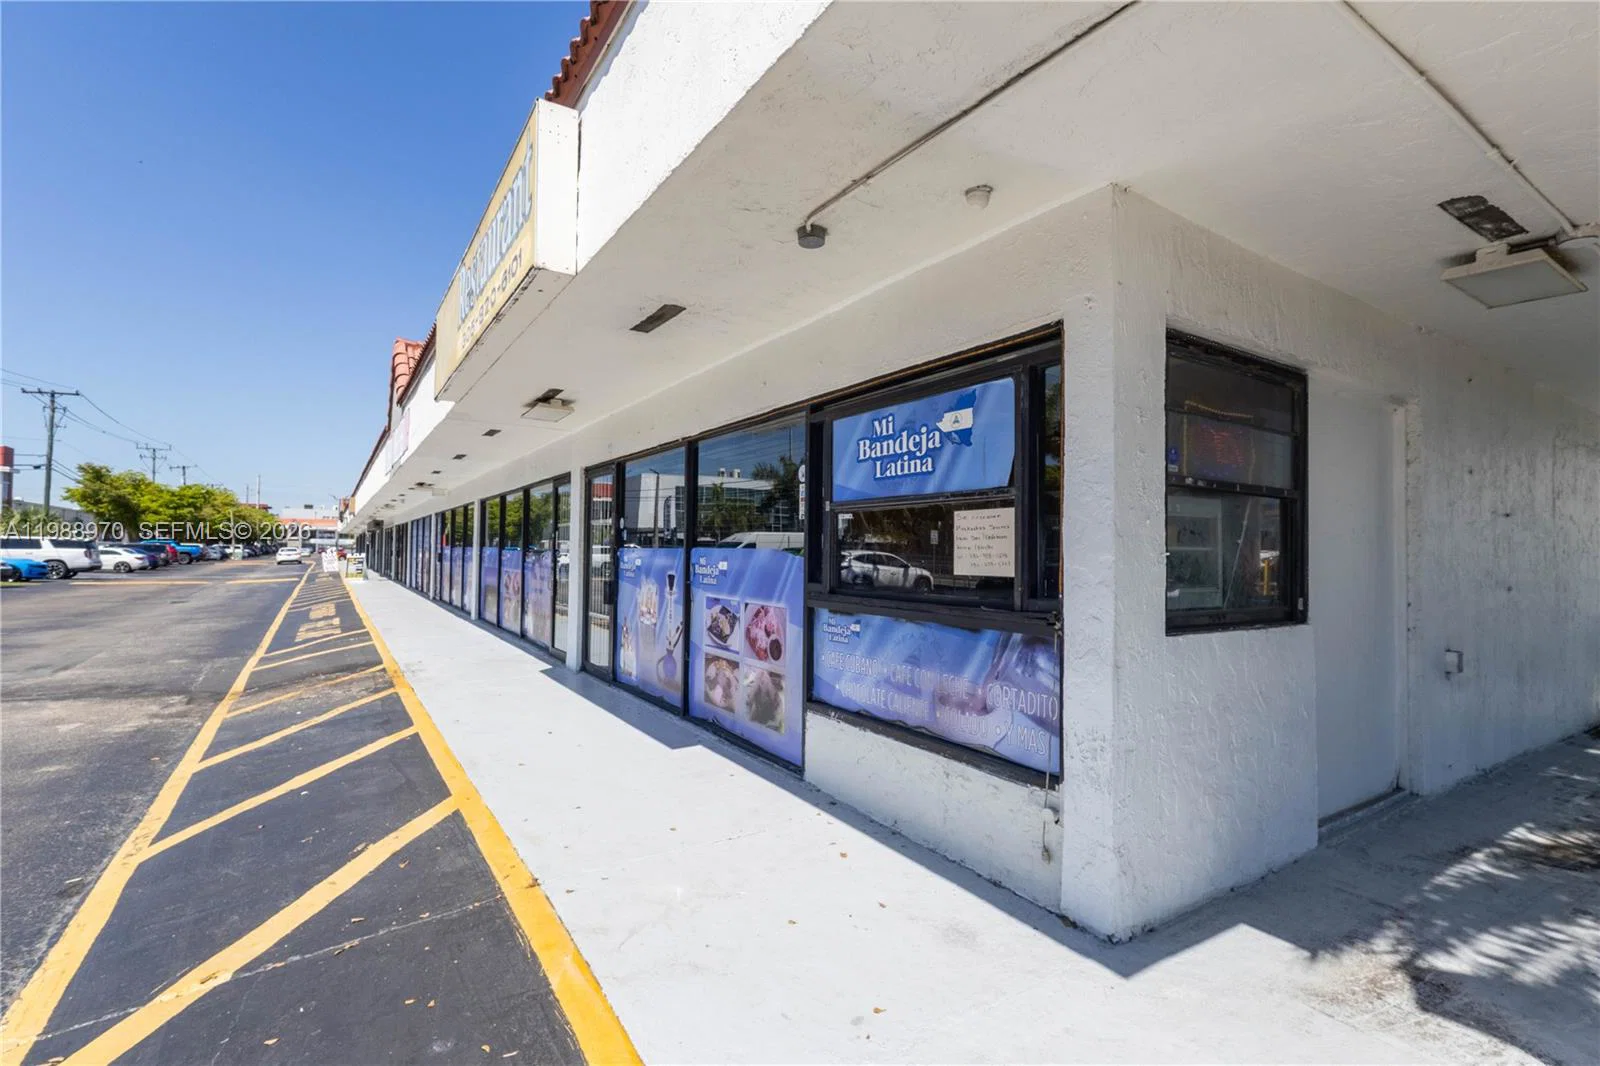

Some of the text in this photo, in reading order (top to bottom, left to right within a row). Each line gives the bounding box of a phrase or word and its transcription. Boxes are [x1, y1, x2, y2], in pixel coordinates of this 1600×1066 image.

[873, 415, 894, 437] Mi
[859, 427, 941, 460] Bandeja
[875, 457, 933, 478] Latina
[986, 683, 1059, 721] CORTADITO
